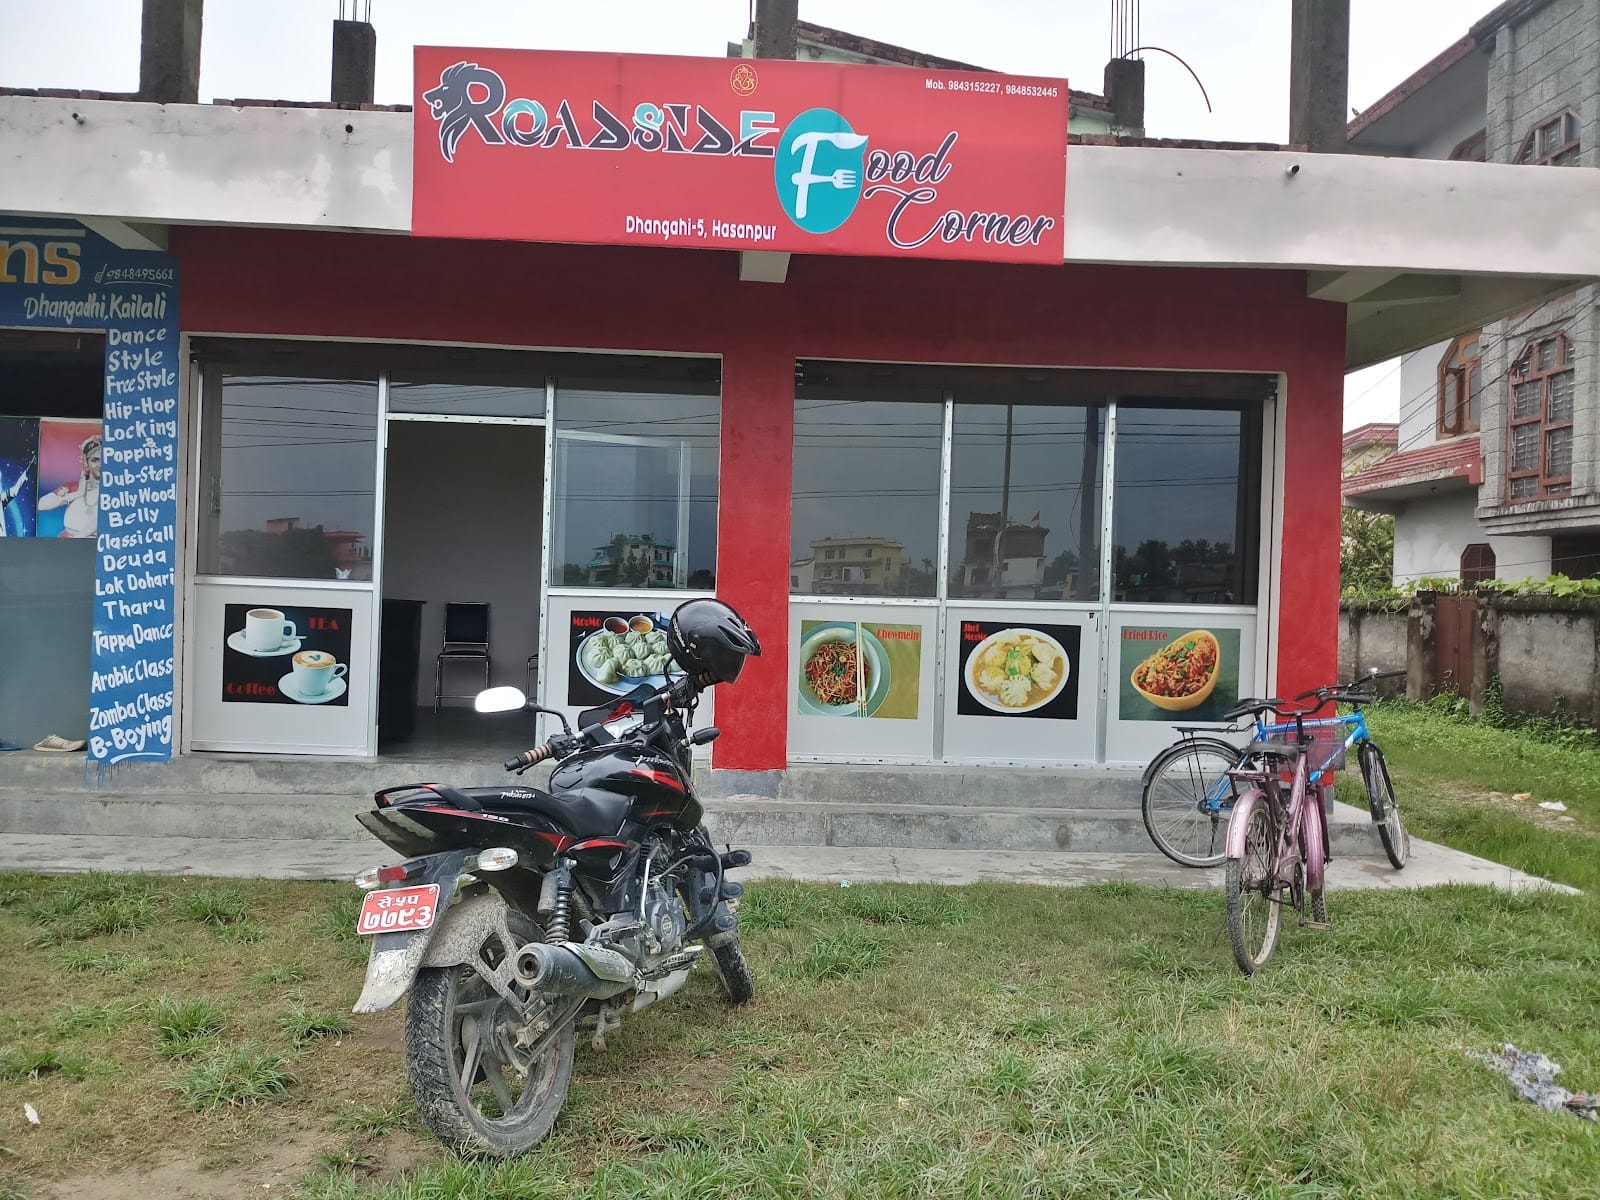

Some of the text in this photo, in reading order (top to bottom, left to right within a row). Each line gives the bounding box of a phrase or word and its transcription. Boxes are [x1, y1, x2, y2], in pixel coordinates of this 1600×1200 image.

[925, 78, 1058, 98] Mob. 9843152227, 9848532445
[791, 130, 959, 220] Food
[863, 184, 1055, 250] Corner
[625, 215, 777, 243] Dhangahi-5, Hasanpur
[108, 327, 167, 346] Dance
[108, 347, 163, 372] Style
[104, 396, 176, 420] Hip-Hop
[104, 419, 176, 442] Locking
[102, 443, 173, 465] Popping
[101, 464, 174, 488] Dub-Step
[108, 507, 160, 528] Belly
[103, 548, 167, 572] Deuda
[102, 598, 166, 620] Tharu
[308, 616, 340, 631] TEA
[1123, 629, 1147, 641] Fried
[226, 682, 277, 697] Coffee
[89, 713, 173, 759] B-Boying
